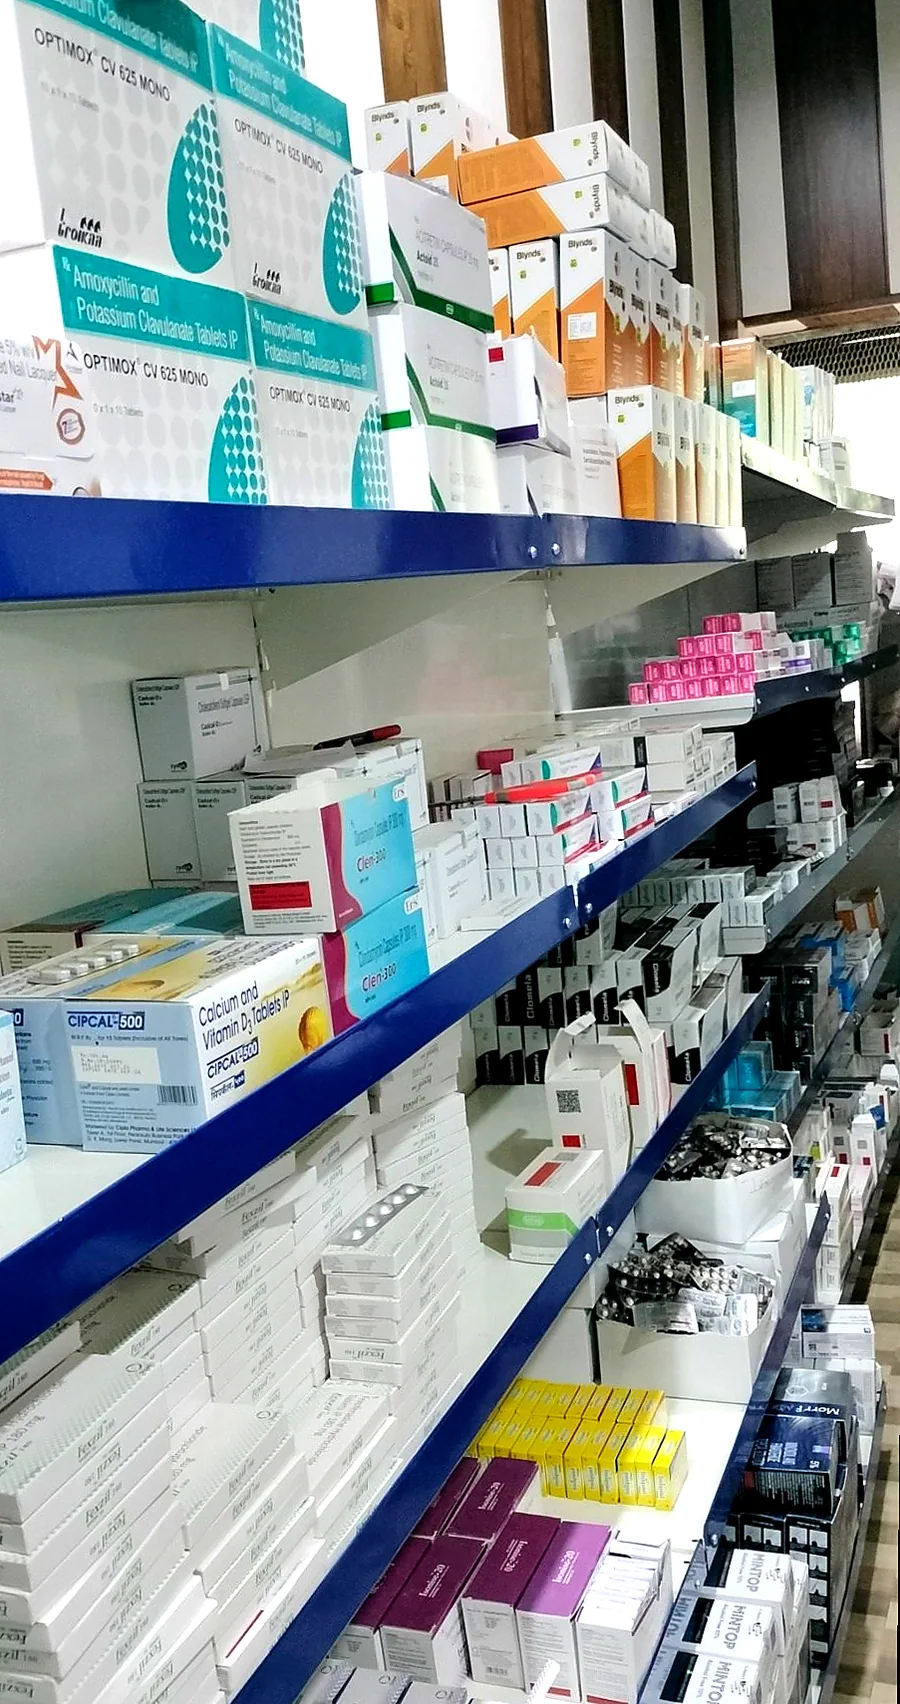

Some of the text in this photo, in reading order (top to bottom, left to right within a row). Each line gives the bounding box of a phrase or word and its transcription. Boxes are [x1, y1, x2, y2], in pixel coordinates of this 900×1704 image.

[35, 28, 171, 101] OPTIMOX CV 625 MONO
[234, 119, 323, 174] OPTIMOX CV 625 MONO
[591, 131, 599, 160] Blynds
[592, 184, 601, 212] Blynds
[516, 250, 541, 260] Blynds
[568, 239, 593, 248] Blynds
[74, 267, 159, 306] Amoxycillin and
[77, 297, 238, 350] Potassium Clavulanate Tablets IP
[83, 353, 209, 387] OPTIMOX CV 625 MONO
[269, 386, 350, 412] OPTIMOX CV 625 MONO
[615, 395, 639, 405] Blynds
[362, 962, 397, 992] Clen-300
[67, 1014, 143, 1029] CIPCAL-500
[199, 980, 259, 1027] Calcium and
[203, 1019, 239, 1050] Vitamin
[252, 997, 281, 1025] Tablets
[282, 989, 290, 1009] IP
[207, 1039, 259, 1079] CIPCAL-500
[86, 1487, 111, 1523] Fexzil
[746, 1553, 765, 1592] MINTOP
[724, 1605, 746, 1650] MINTOP
